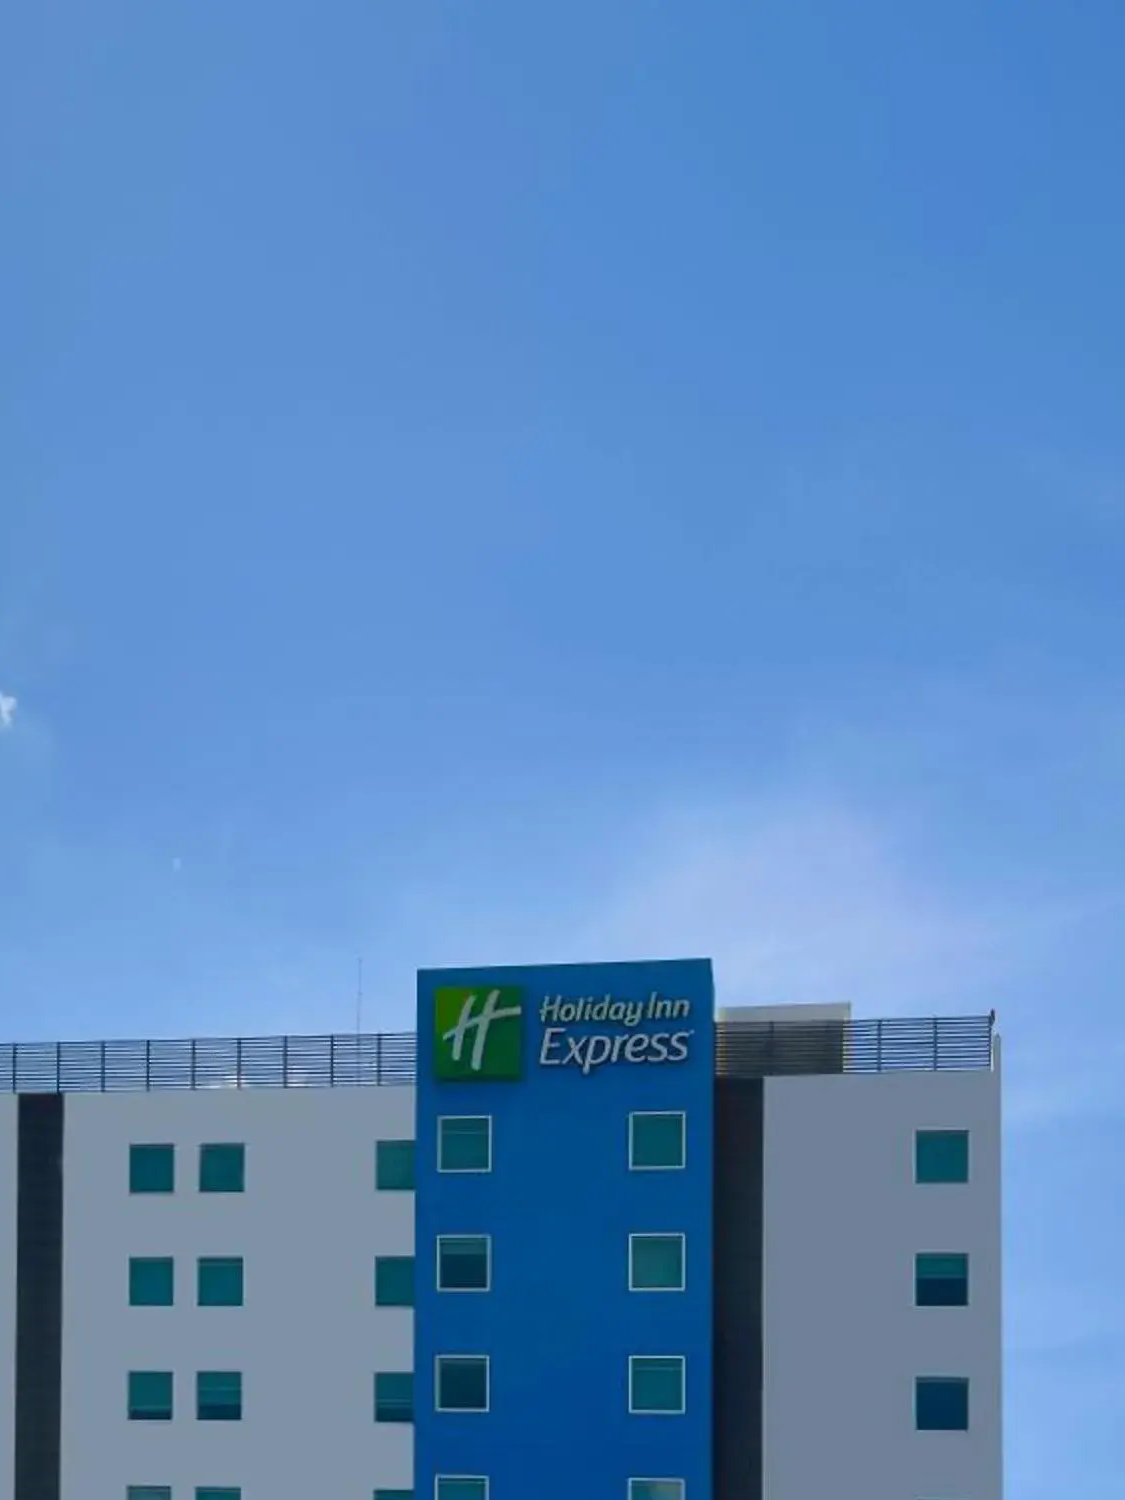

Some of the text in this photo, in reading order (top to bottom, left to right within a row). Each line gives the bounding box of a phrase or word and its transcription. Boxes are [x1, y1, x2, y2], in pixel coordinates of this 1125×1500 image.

[539, 991, 691, 1027] Holiday Inn
[539, 1027, 691, 1075] Express
